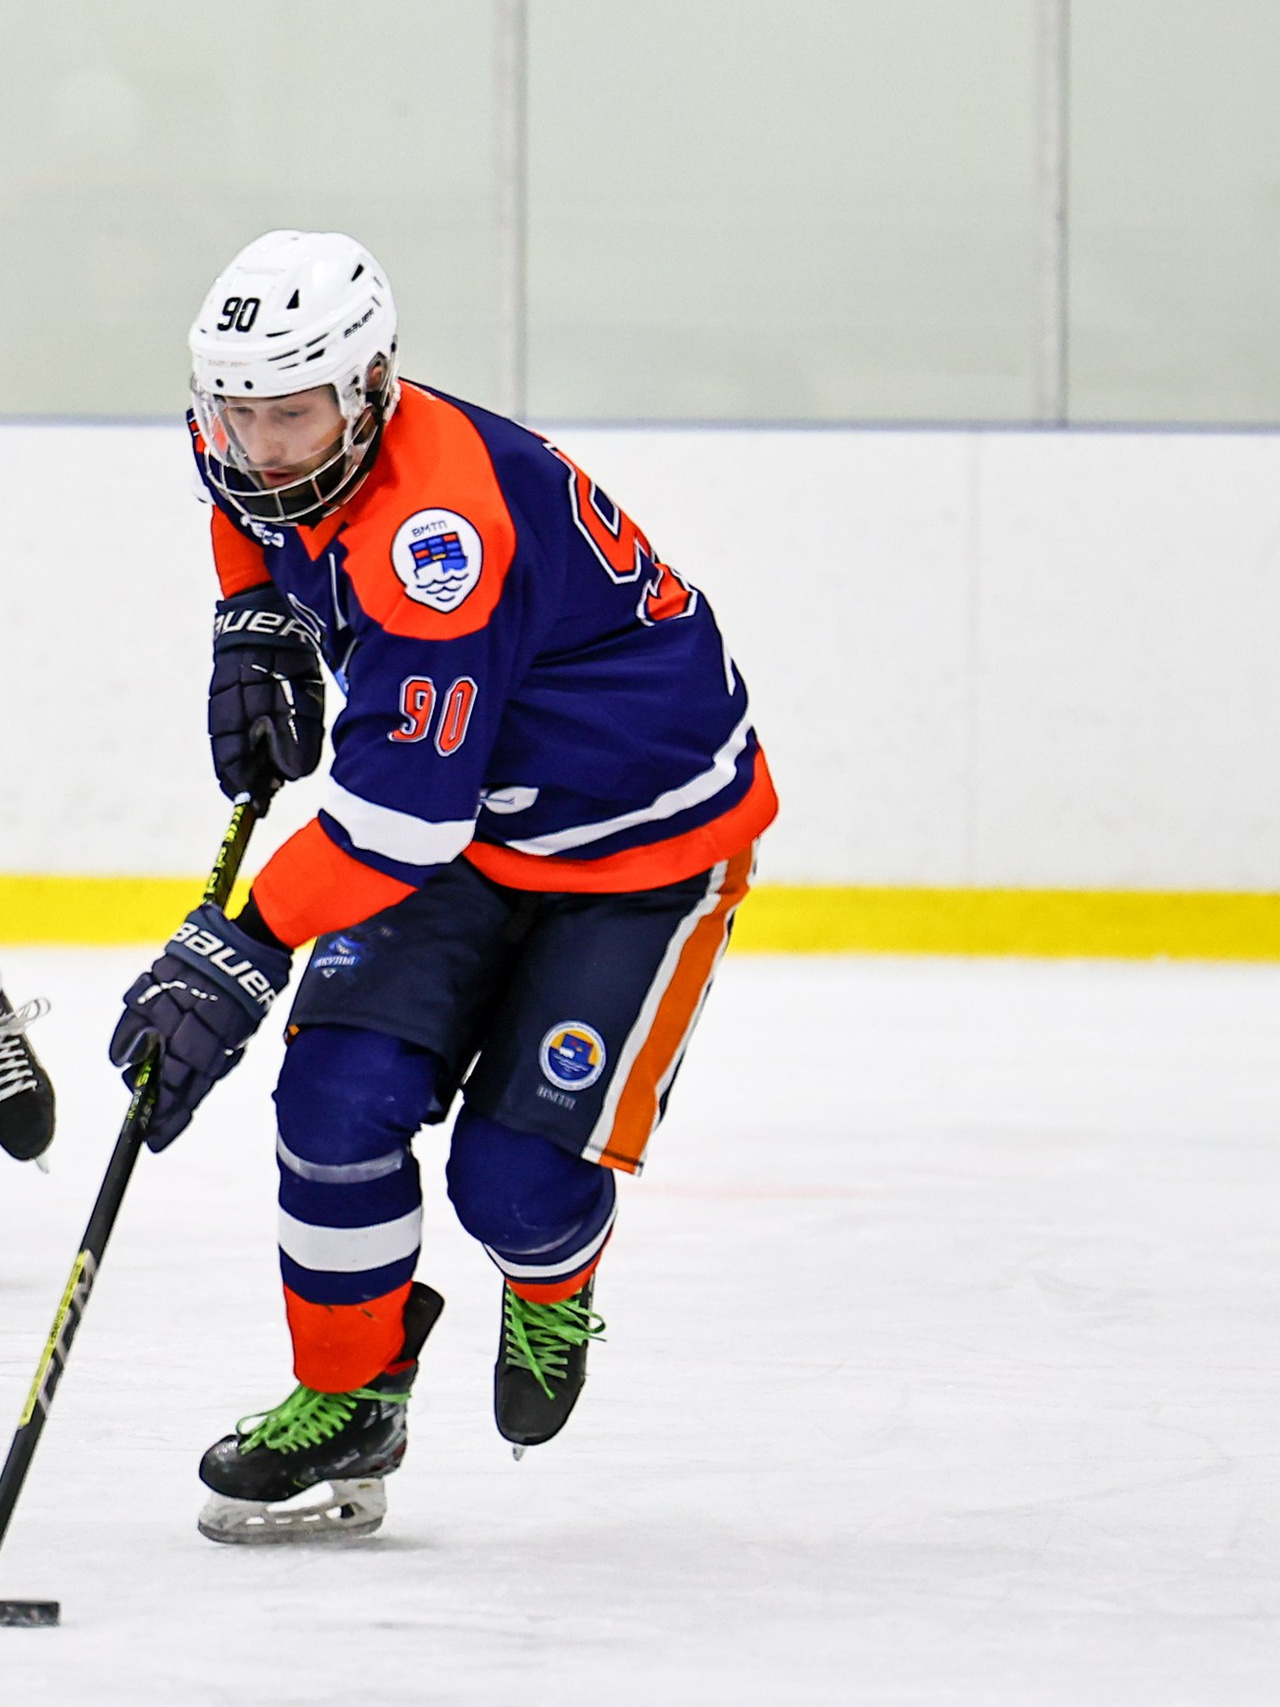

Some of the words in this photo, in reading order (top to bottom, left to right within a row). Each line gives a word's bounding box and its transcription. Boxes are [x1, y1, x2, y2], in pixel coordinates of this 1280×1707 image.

[217, 296, 261, 333] 90
[343, 307, 376, 339] BAUER
[386, 675, 479, 758] 90
